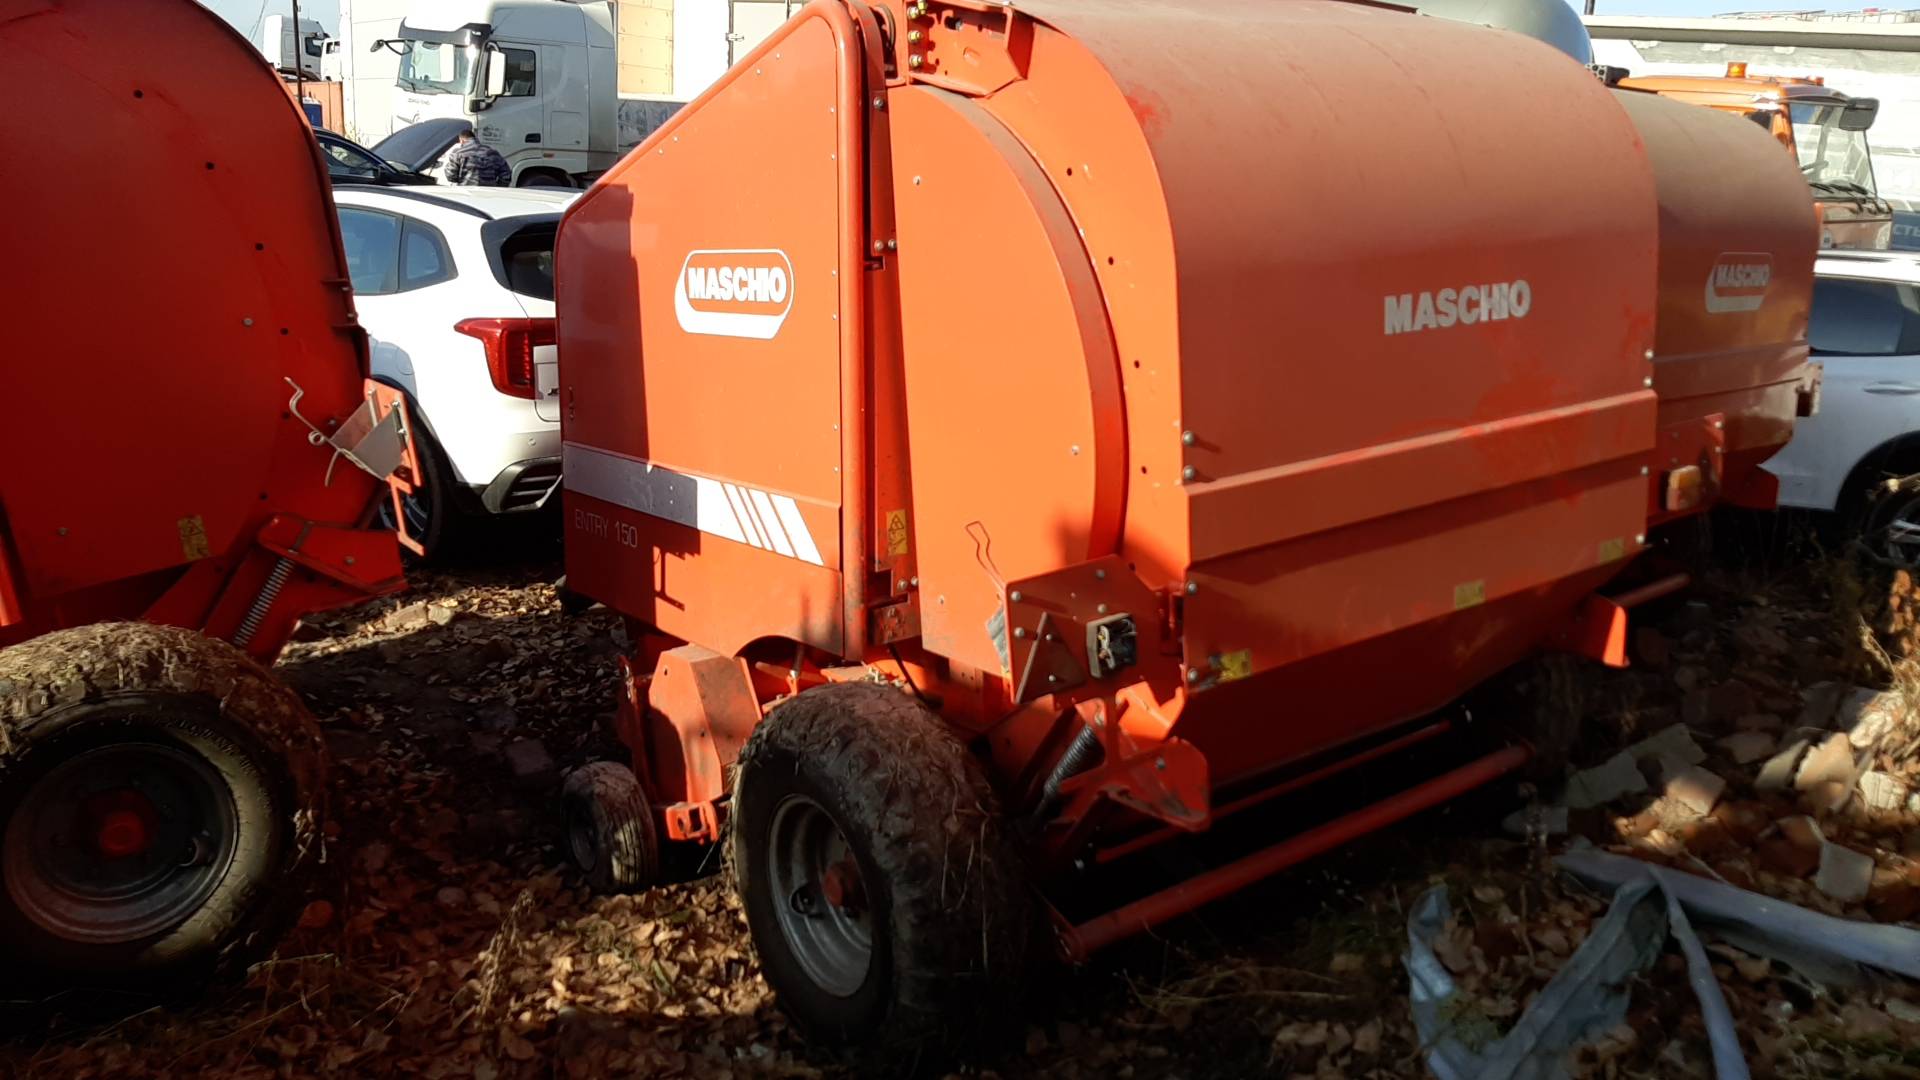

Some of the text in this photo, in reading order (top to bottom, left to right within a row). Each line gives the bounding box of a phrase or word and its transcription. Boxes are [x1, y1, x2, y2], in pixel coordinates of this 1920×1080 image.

[687, 266, 787, 303] MASCHIO
[1715, 263, 1770, 288] MASCHIO
[1384, 280, 1531, 335] MASCHIO
[575, 508, 638, 548] ENTRY 150
